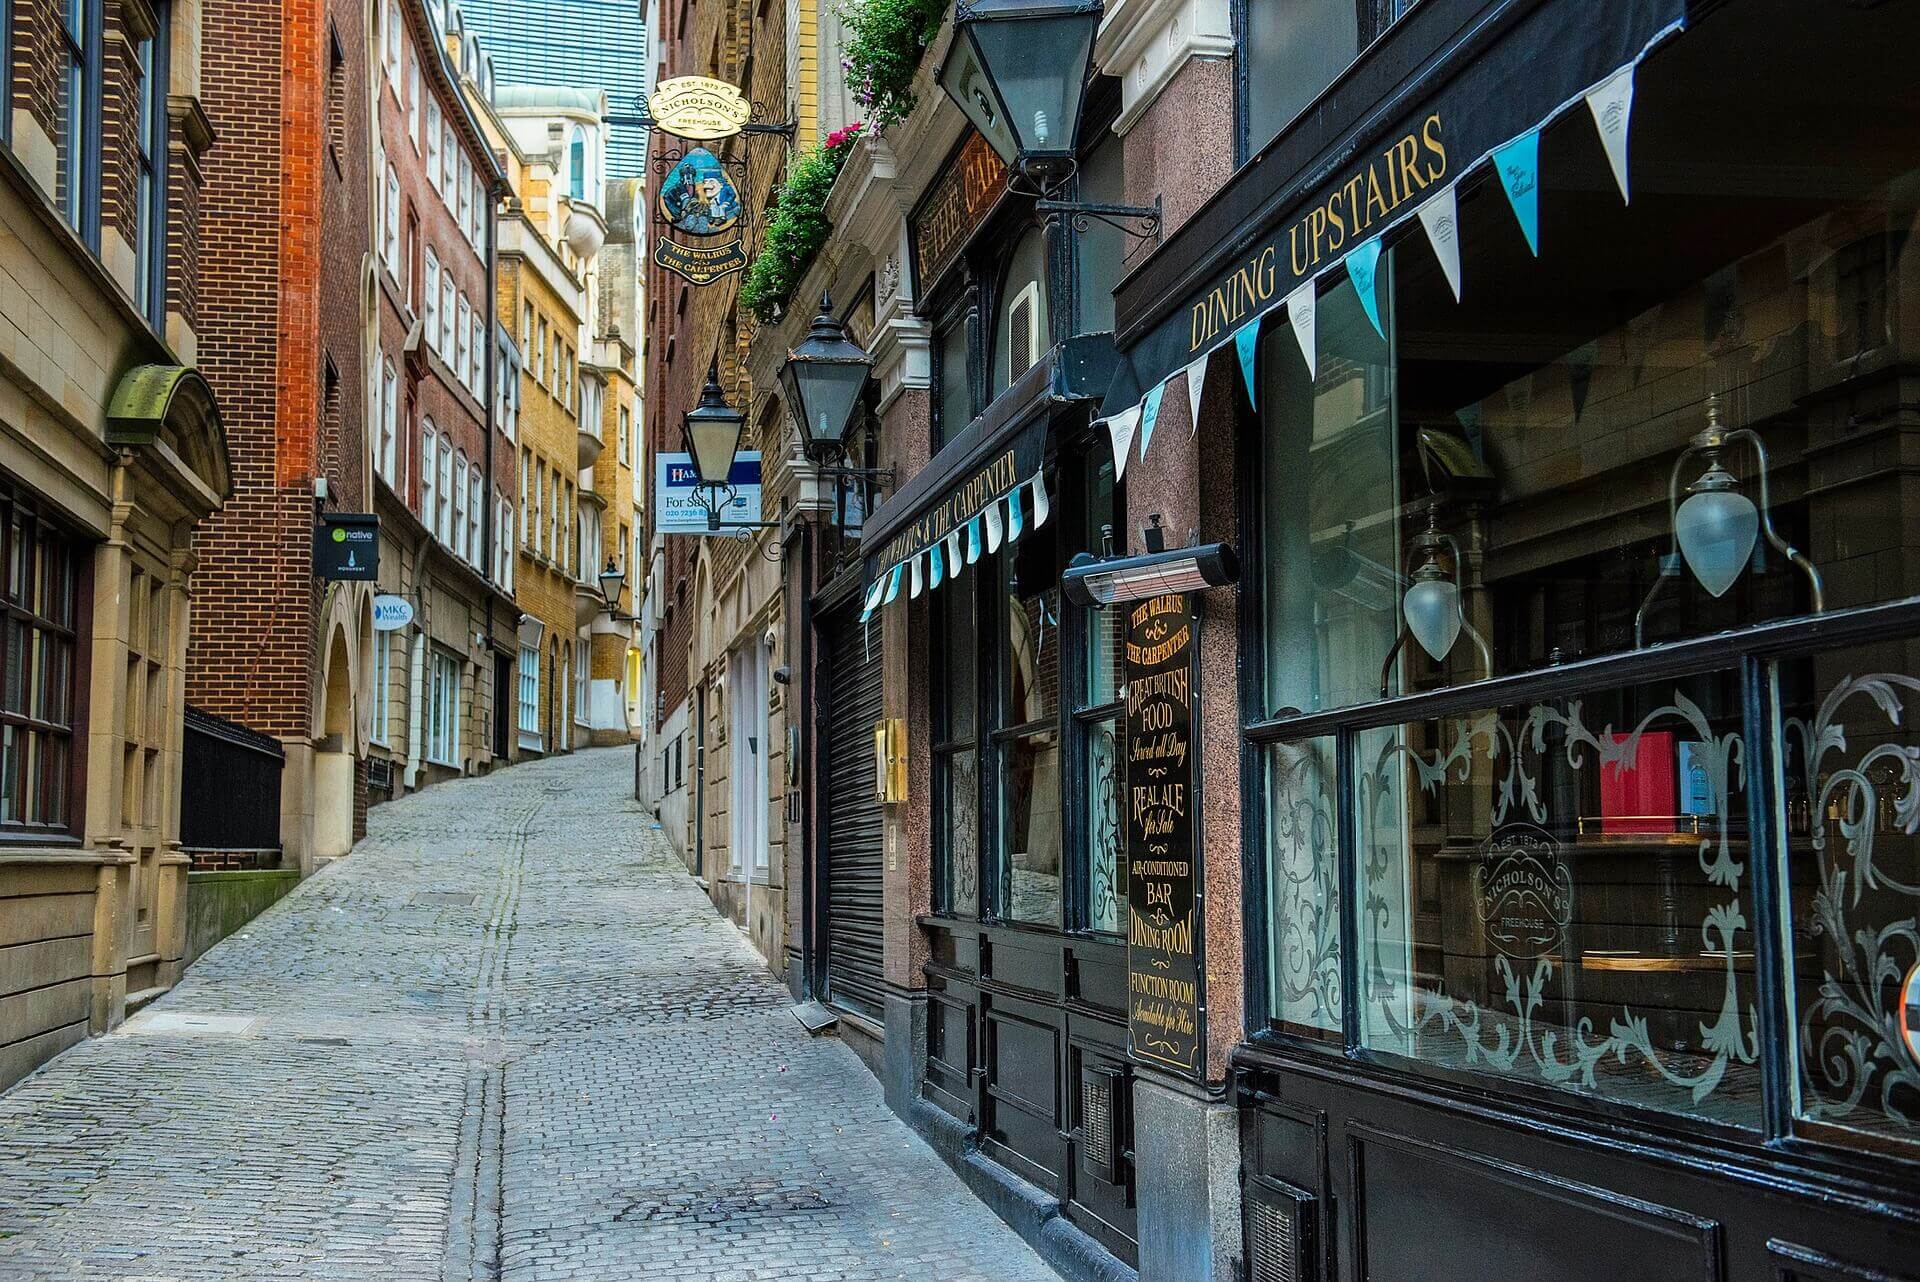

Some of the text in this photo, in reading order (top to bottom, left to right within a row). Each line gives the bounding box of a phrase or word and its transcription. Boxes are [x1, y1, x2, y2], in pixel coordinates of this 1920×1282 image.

[661, 97, 739, 118] NICHOLSON'S
[678, 118, 721, 126] FREEHOUSE
[1189, 111, 1447, 353] DINING UPSTAIRS
[663, 254, 682, 269] THE
[684, 257, 742, 273] CARPENTER
[671, 245, 732, 259] THE WALRUS
[666, 497, 684, 508] For
[933, 501, 950, 540] THE
[953, 449, 1017, 524] CARPENTER
[346, 531, 373, 539] native
[1131, 594, 1183, 630] THE WALRUS
[1126, 624, 1190, 666] THE CARPENTER
[1128, 666, 1189, 718] GREAT BRITISH
[1142, 702, 1173, 732] FOOD
[1129, 731, 1187, 767] Served all Day
[1133, 783, 1184, 828] REAL ALE
[1143, 809, 1175, 841] for Sale
[1519, 834, 1538, 849] 1873
[1132, 860, 1189, 880] AIR-CONDITIONED
[1146, 882, 1174, 916] BAR
[1484, 870, 1561, 910] NICHOLSON'S
[1130, 903, 1193, 961] DINING ROOM
[1149, 907, 1169, 926] &
[1501, 917, 1544, 930] FREEHOUSE
[1131, 972, 1194, 1006] FUNCTION ROOM
[1132, 999, 1194, 1036] Available for Hire
